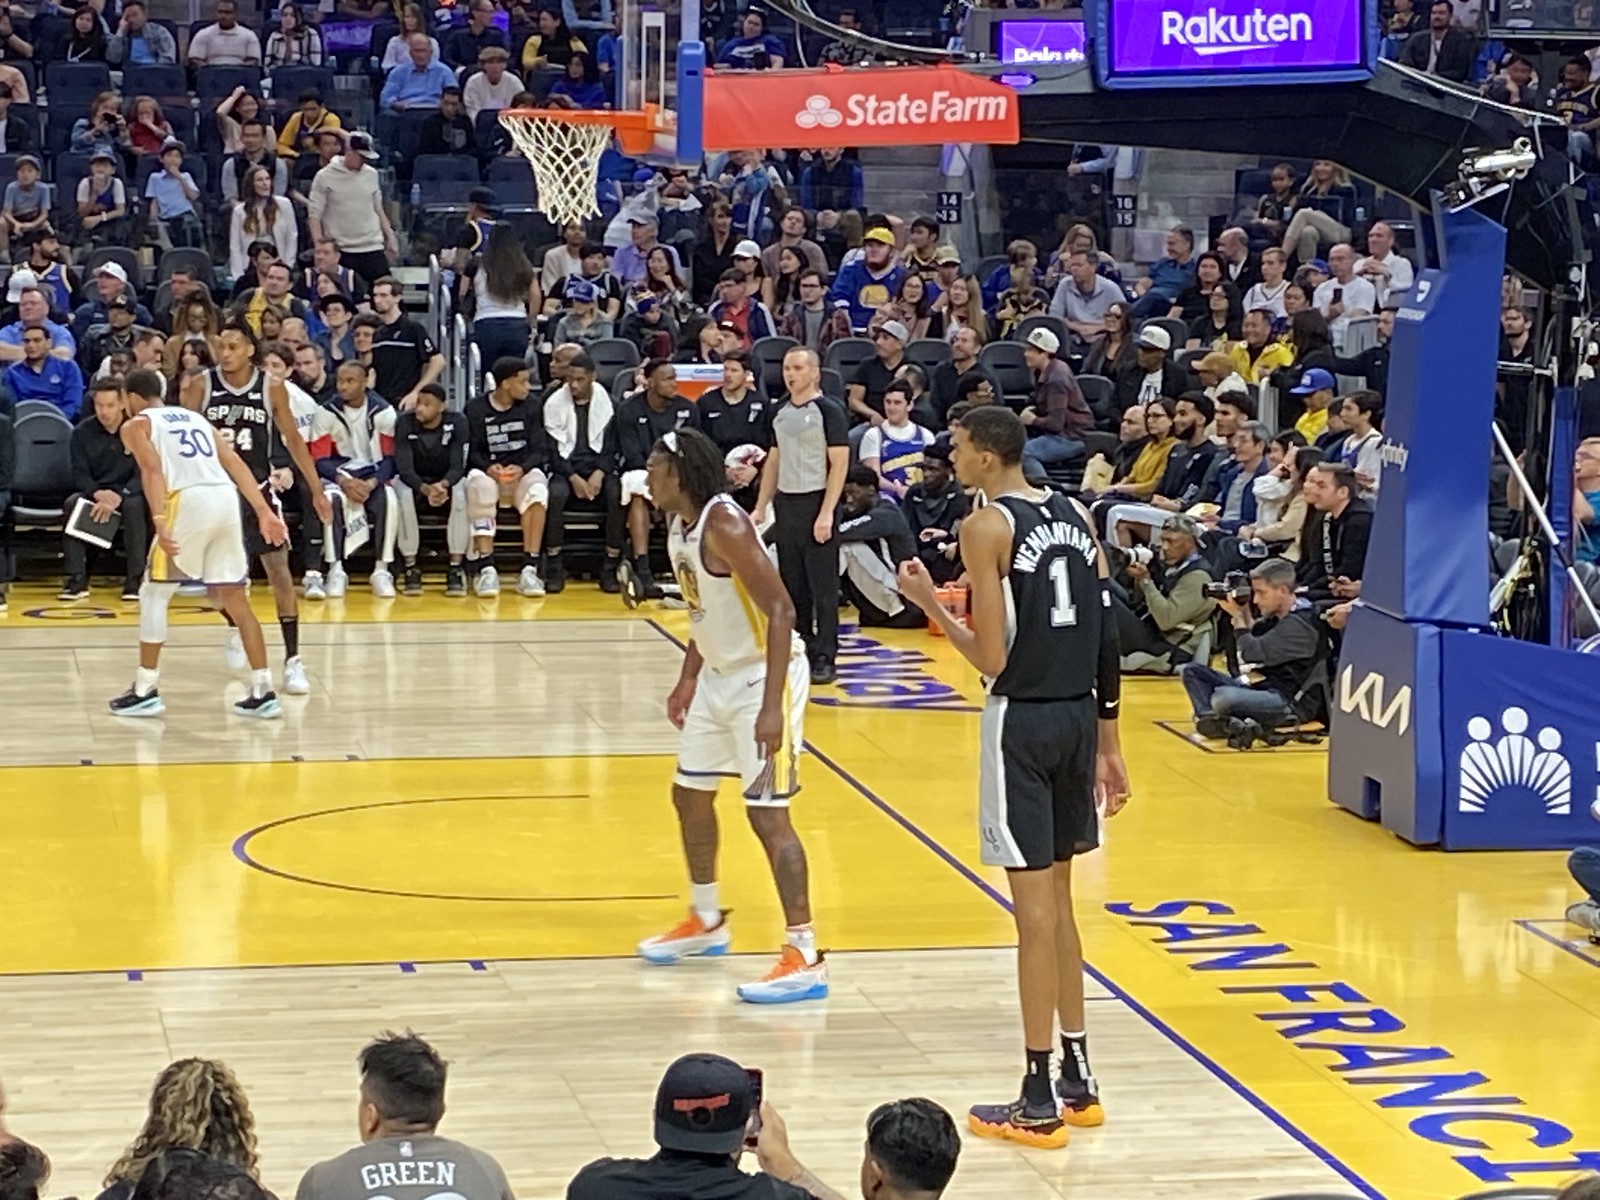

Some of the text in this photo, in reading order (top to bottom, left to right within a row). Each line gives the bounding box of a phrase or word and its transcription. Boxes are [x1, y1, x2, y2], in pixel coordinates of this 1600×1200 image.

[1161, 7, 1313, 46] Rakuten
[1116, 212, 1133, 225] 15
[168, 428, 214, 459] 30
[221, 428, 254, 451] 24
[1048, 555, 1078, 627] 1
[1103, 900, 1321, 972] SAN
[360, 1160, 456, 1191] GREEN
